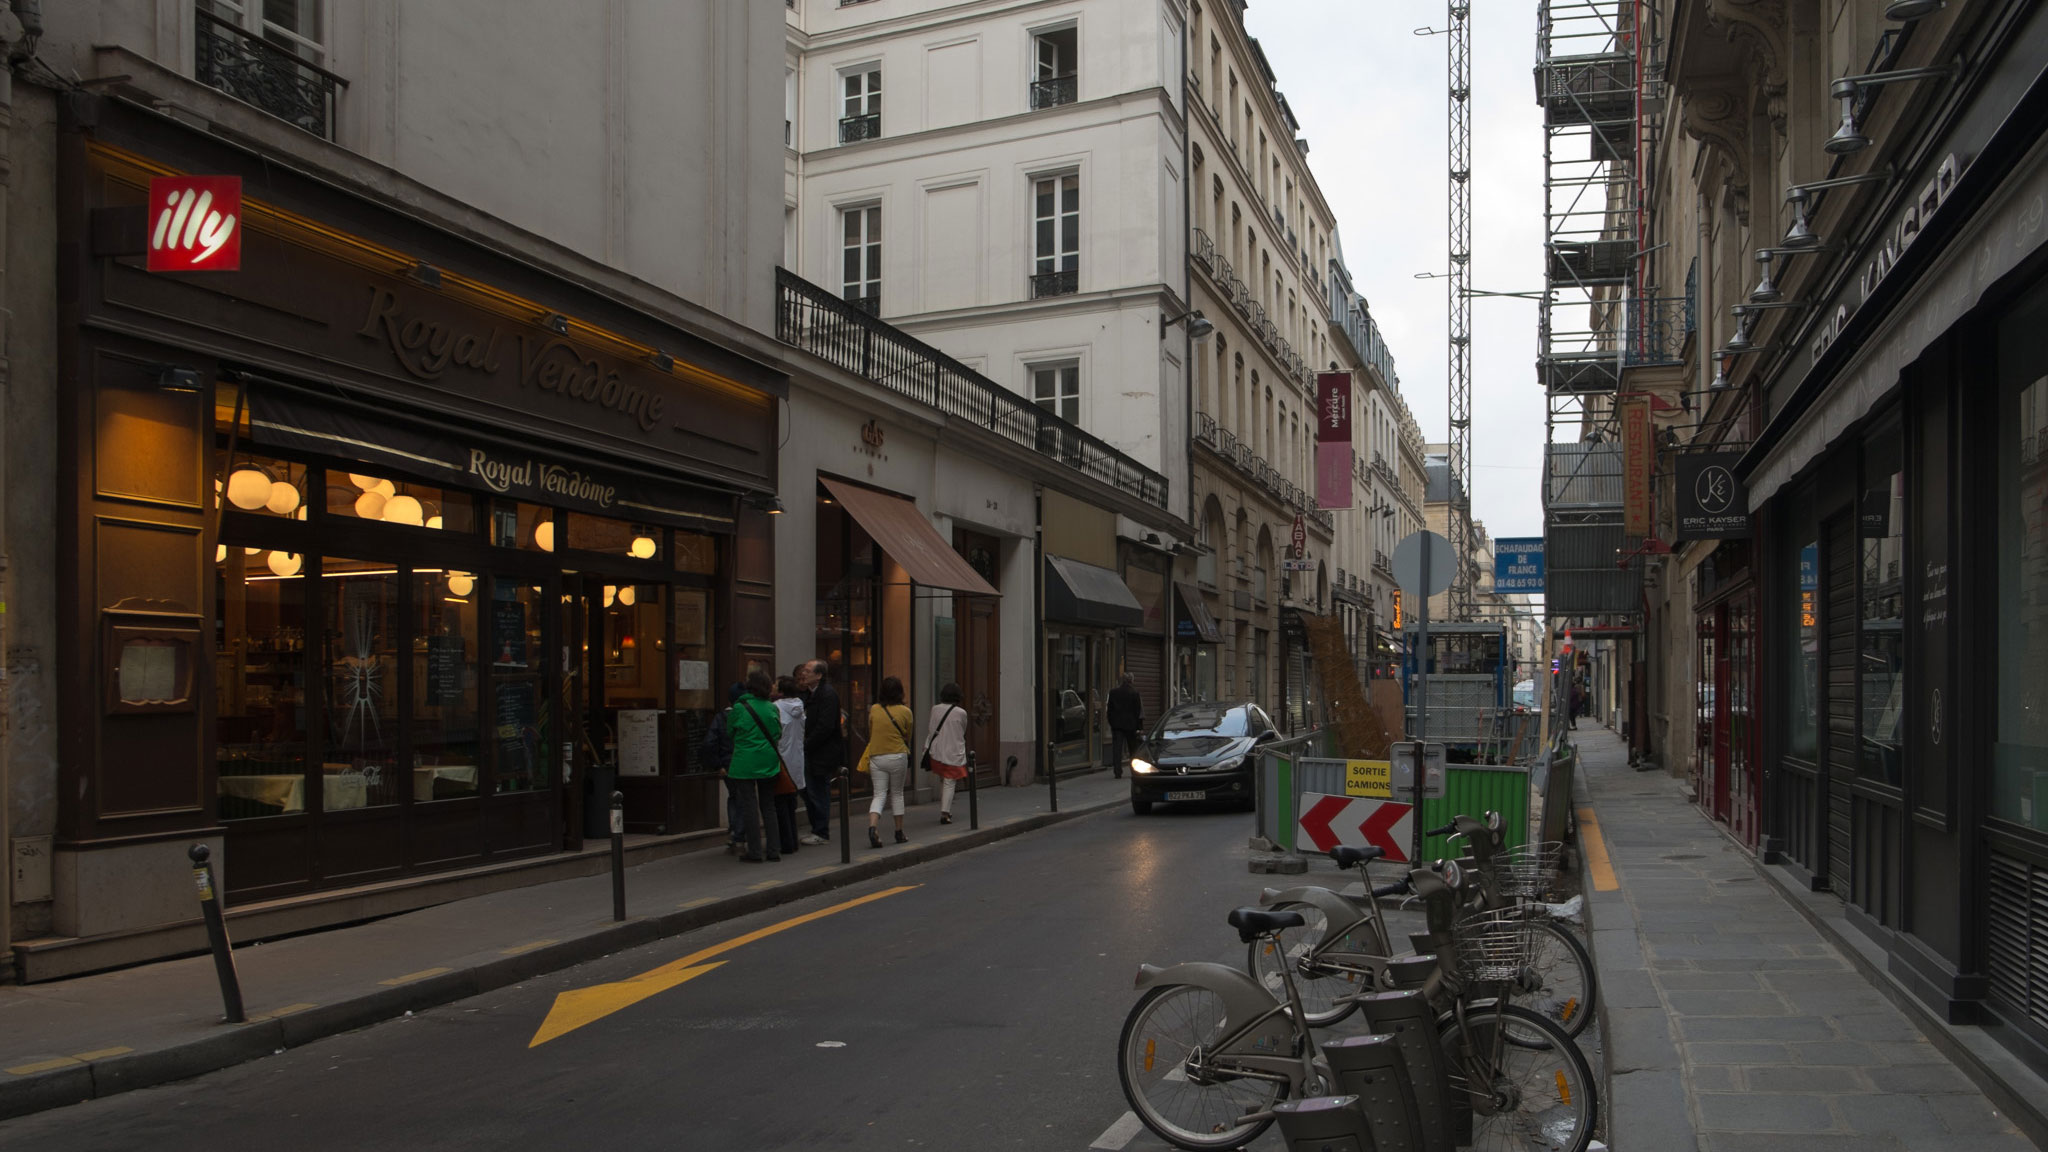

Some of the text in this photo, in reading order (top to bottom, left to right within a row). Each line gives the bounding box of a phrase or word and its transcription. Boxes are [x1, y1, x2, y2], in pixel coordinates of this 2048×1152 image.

[152, 188, 236, 263] illy
[359, 285, 666, 433] Royal Vendôme
[1330, 387, 1339, 428] Mercure
[1628, 407, 1644, 509] RESTAURANT
[468, 447, 616, 508] Royal Vendôme
[1683, 516, 1746, 525] ERIC KAYSER
[1294, 514, 1304, 559] TABAC
[1508, 565, 1537, 575] FRANCE
[1517, 554, 1528, 564] DE
[1496, 577, 1544, 588] 01 48 65 93 0
[1352, 766, 1387, 776] SORTIE
[1347, 780, 1391, 790] CAMIONS
